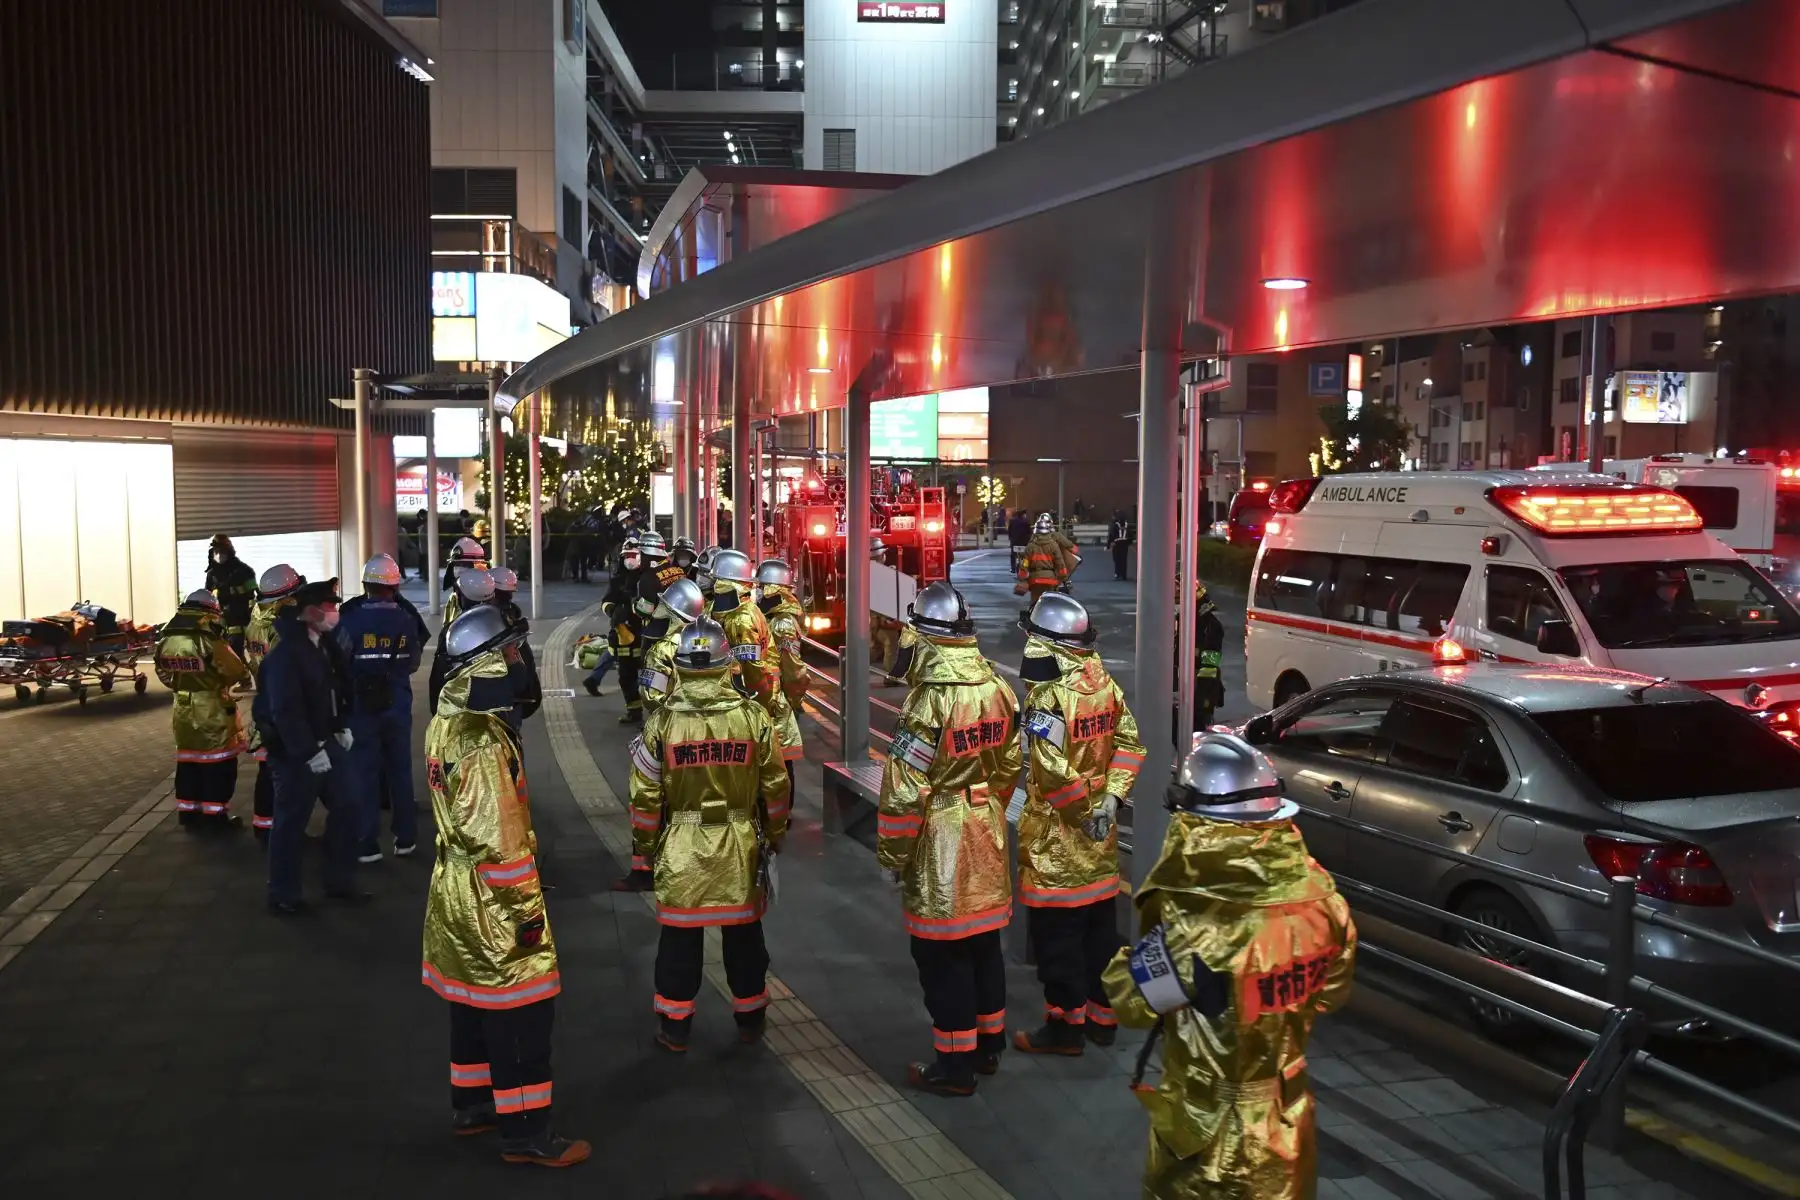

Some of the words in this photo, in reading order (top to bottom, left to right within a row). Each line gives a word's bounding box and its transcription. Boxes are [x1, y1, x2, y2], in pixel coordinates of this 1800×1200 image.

[1318, 367, 1335, 387] P
[1320, 486, 1408, 503] AMBULANCE
[673, 742, 747, 766] 調布市消防団
